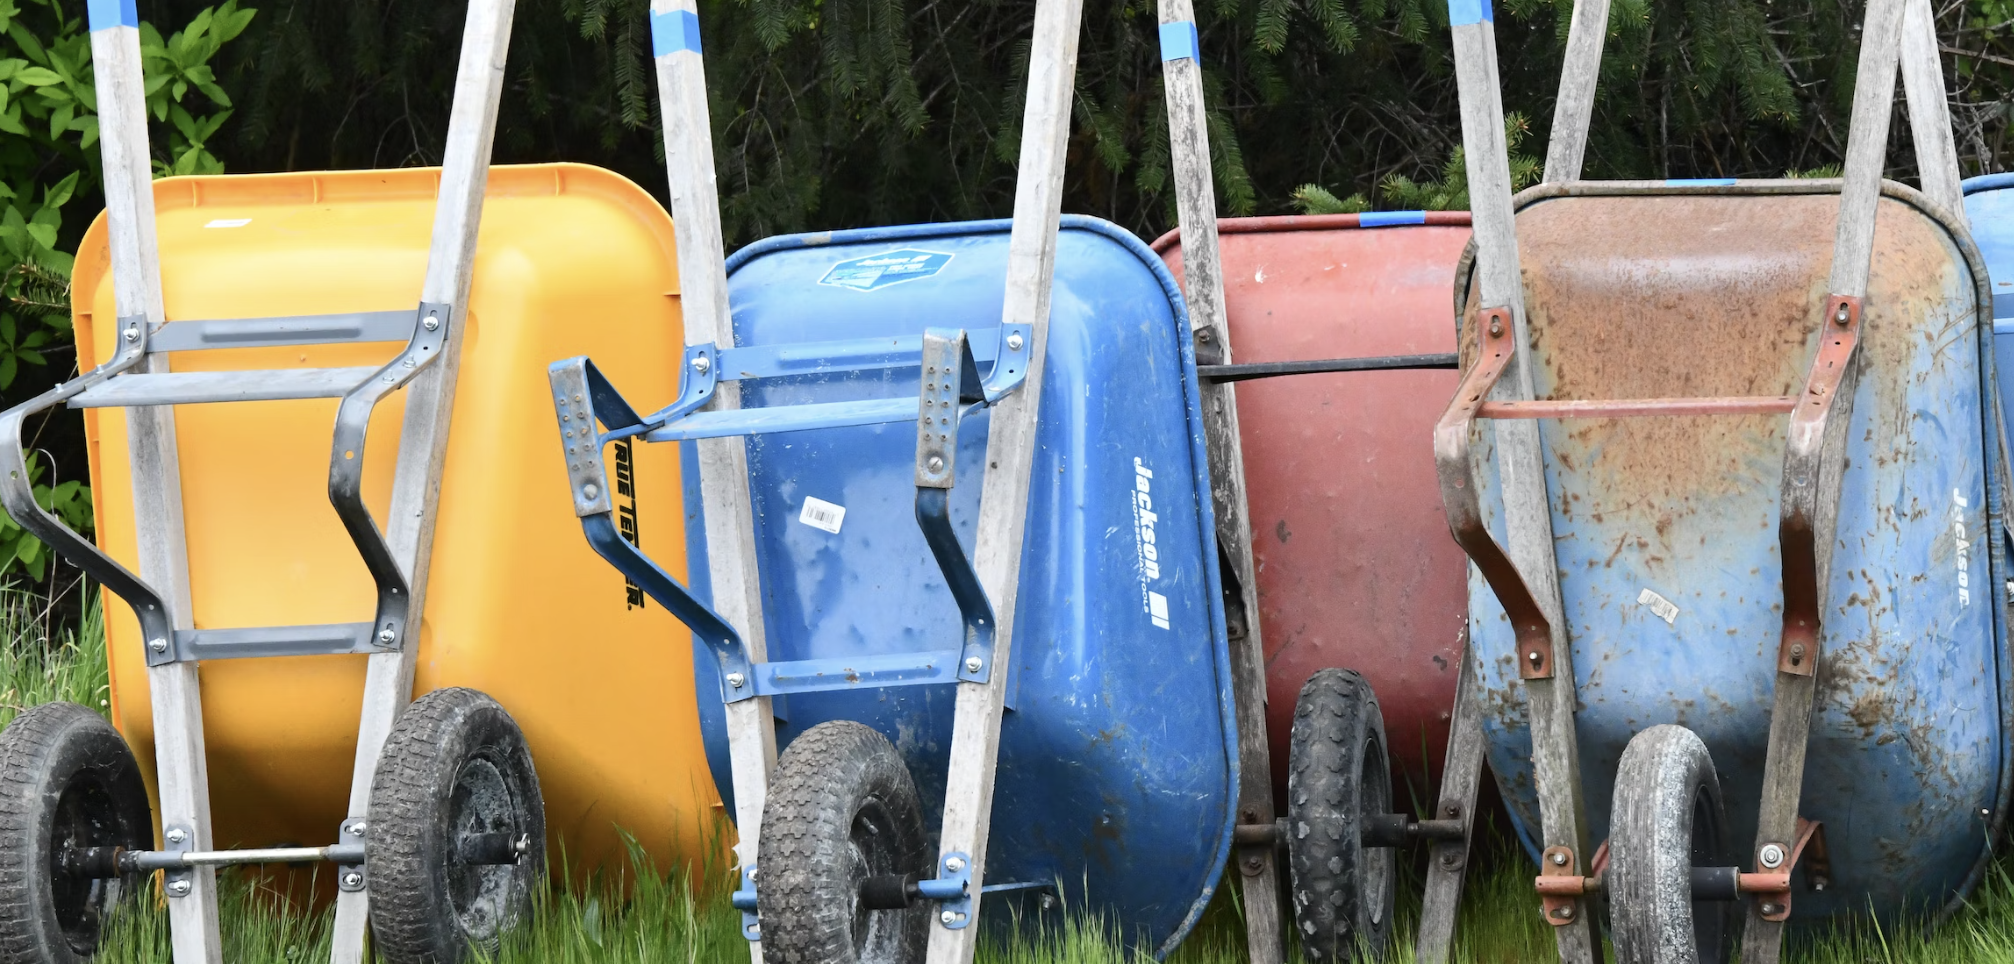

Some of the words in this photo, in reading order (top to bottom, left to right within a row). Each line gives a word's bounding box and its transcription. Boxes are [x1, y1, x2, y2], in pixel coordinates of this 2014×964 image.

[1130, 489, 1144, 574] PROFESSIONAL
[1140, 577, 1149, 613] TOOLS
[1133, 456, 1160, 581] Jackson
